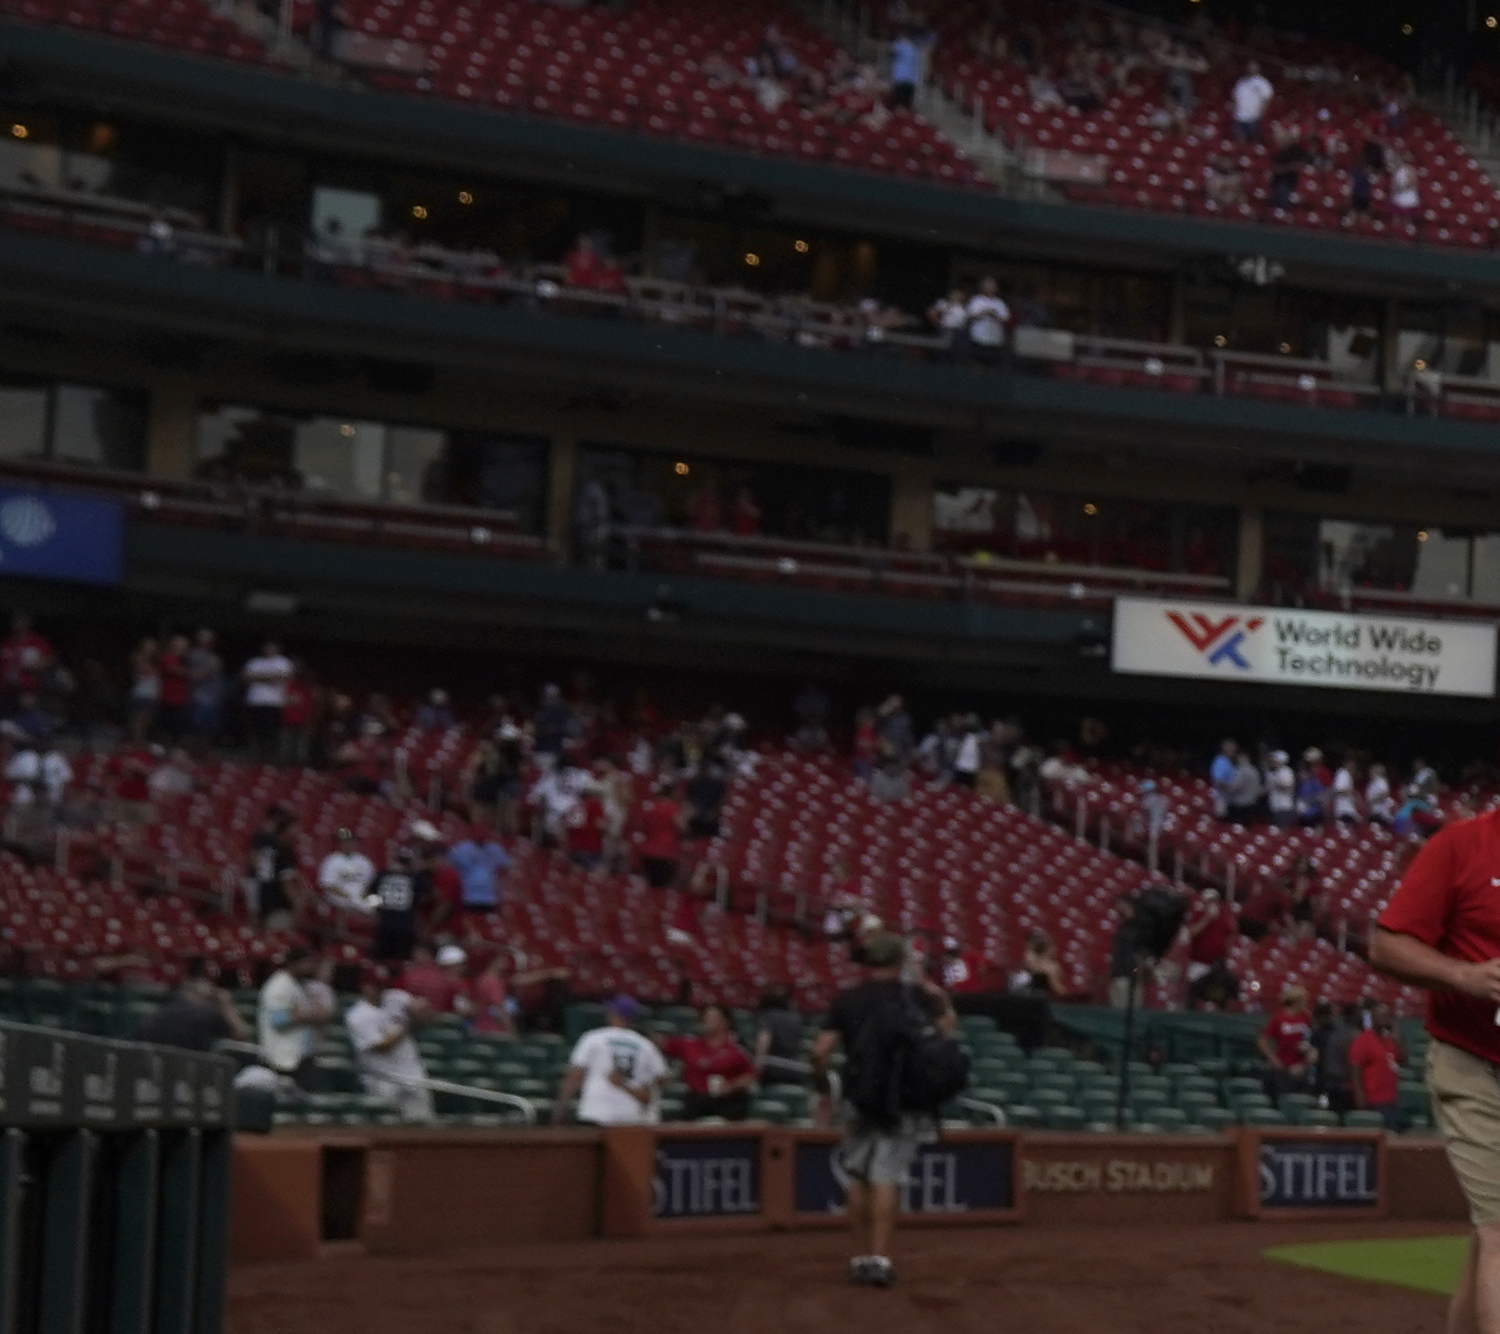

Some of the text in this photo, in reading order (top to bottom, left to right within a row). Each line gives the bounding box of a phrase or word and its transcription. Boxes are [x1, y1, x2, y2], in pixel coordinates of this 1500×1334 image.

[1276, 618, 1443, 654] World Wide
[1276, 648, 1440, 688] Technology
[652, 1148, 761, 1216] STIFEL
[1260, 1145, 1378, 1201] STIFEL
